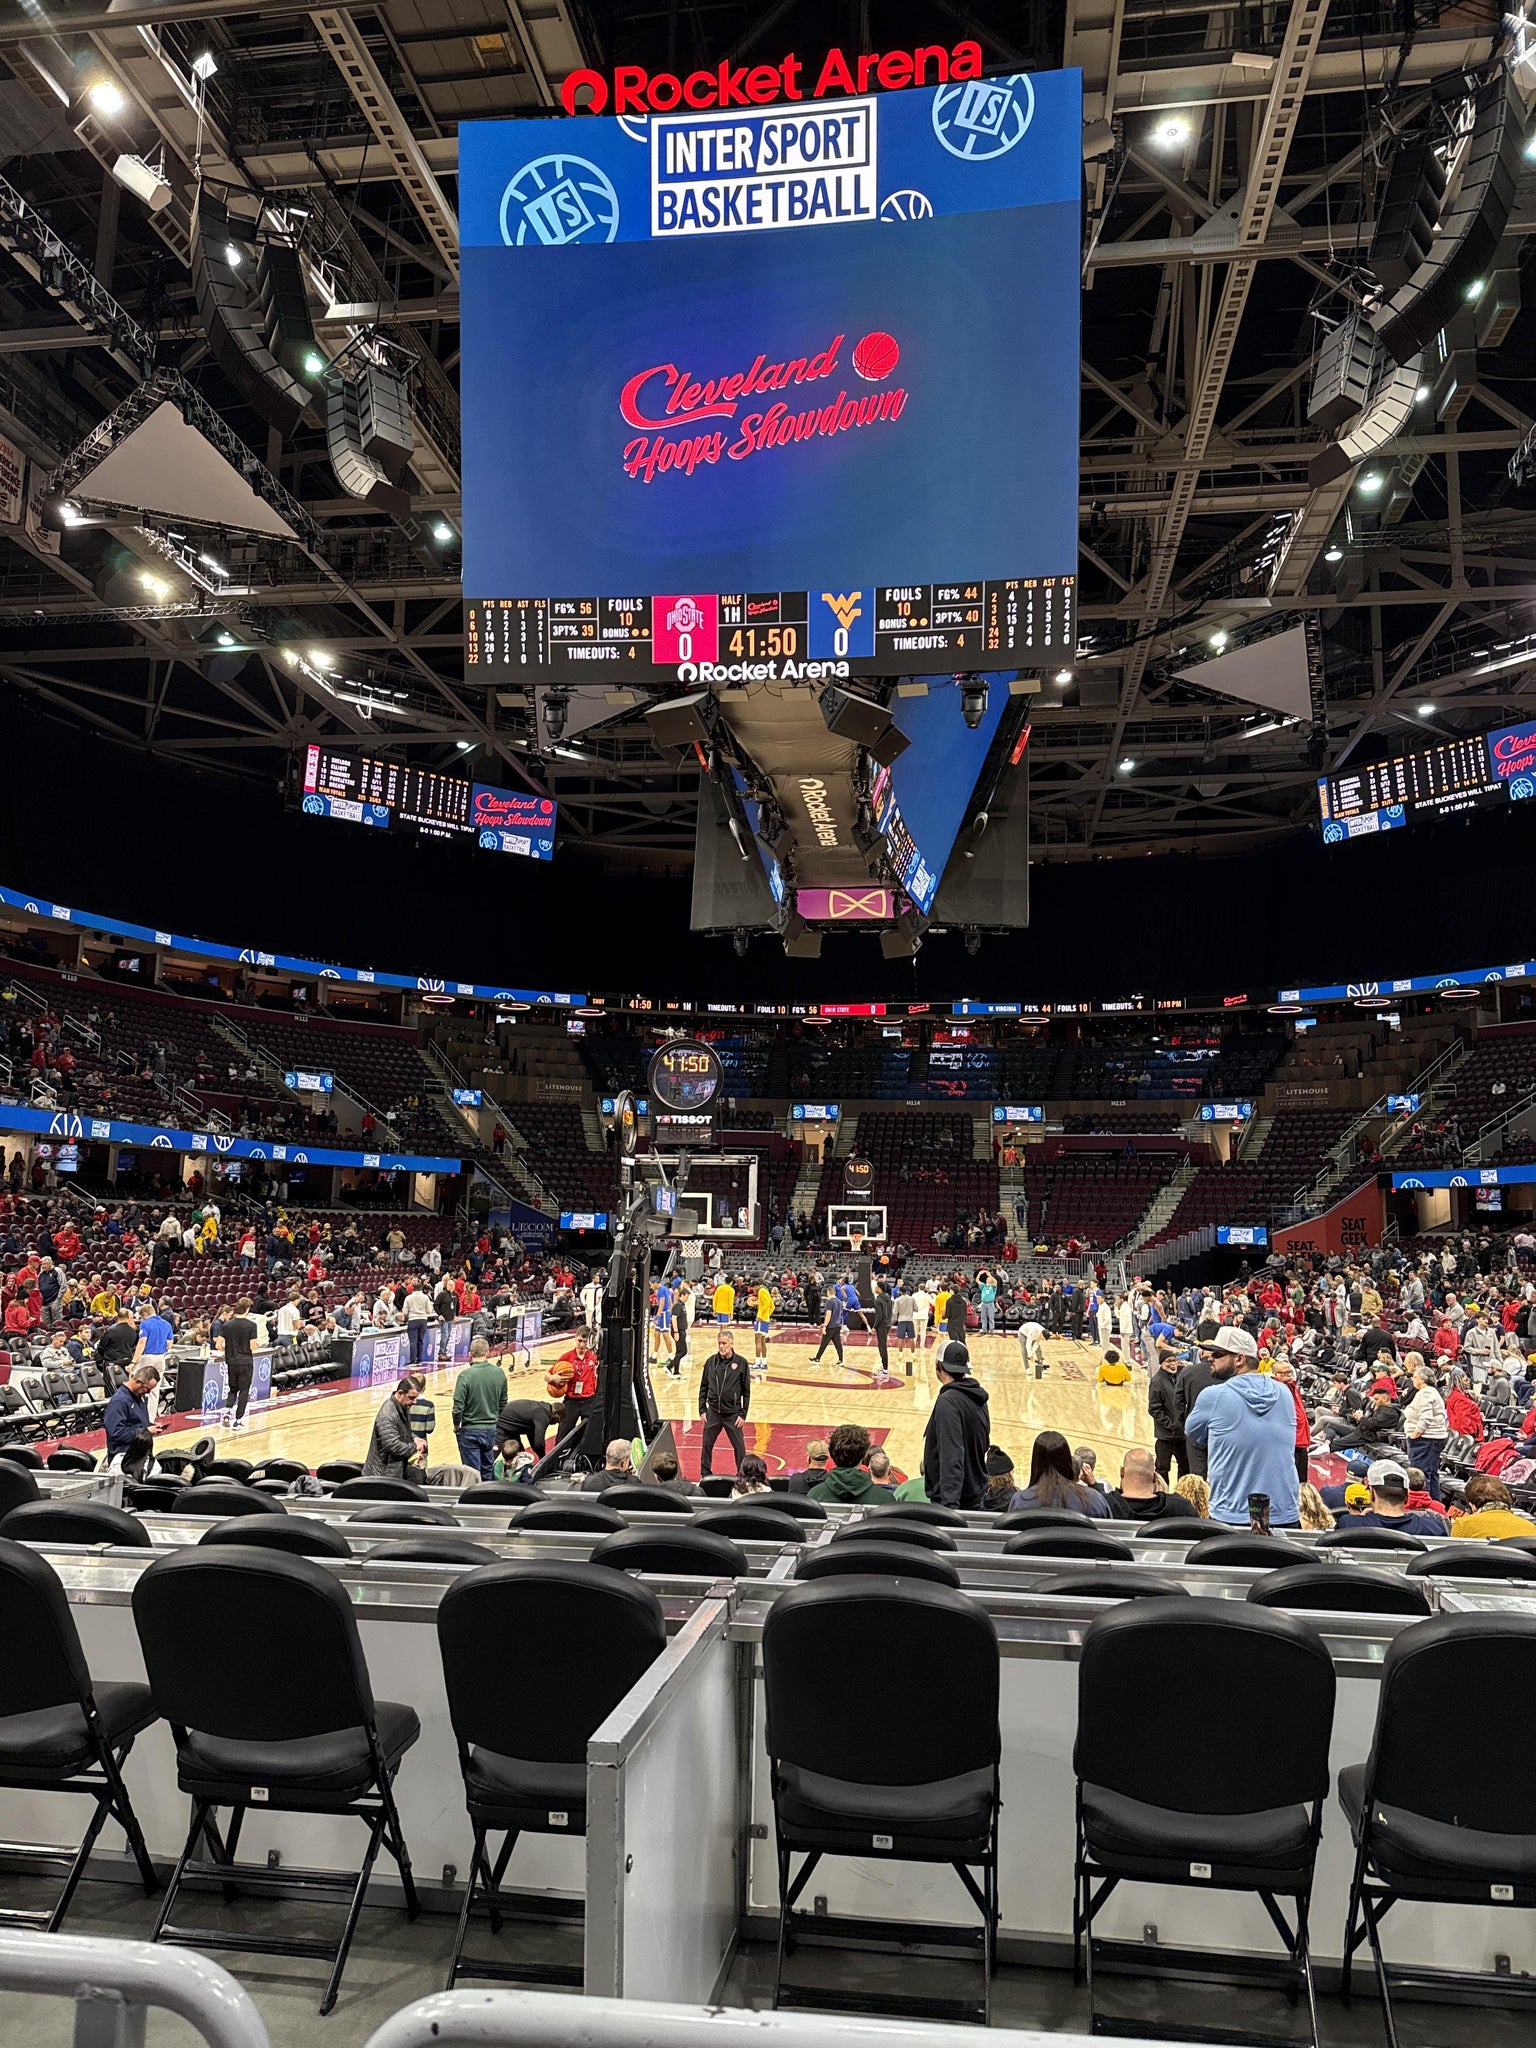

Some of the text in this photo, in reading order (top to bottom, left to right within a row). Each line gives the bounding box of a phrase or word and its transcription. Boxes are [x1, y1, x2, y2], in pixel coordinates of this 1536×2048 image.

[615, 40, 983, 114] Rocket Arena
[659, 175, 870, 229] BASKETBALL
[619, 334, 845, 430] Cleveland
[623, 388, 908, 483] Hoops Showdown
[1005, 577, 1075, 589] PTS REB AST FLS
[721, 595, 741, 605] HALF
[886, 588, 922, 601] FOULS
[938, 587, 978, 600] FG% 44
[991, 587, 1071, 603] 2 4 1 0 0
[517, 600, 529, 608] AST
[534, 600, 546, 608] FLS
[555, 602, 592, 614] FG% 56
[608, 599, 643, 611] FOULS
[897, 602, 911, 616] 10
[991, 599, 1070, 614] 3 12 4 3 2
[619, 613, 633, 625] 10
[723, 606, 741, 623] 1H
[935, 610, 979, 624] 3PT% 40
[991, 611, 1070, 626] 5 15 3 5 4
[553, 625, 594, 636] 3PT% 39
[879, 618, 907, 629] BONUS
[988, 622, 1070, 637] 24 9 4 2 2
[603, 628, 629, 638] BONUS
[679, 633, 692, 660] 0
[729, 627, 796, 657] 41:50
[834, 628, 848, 656] 0
[893, 634, 965, 650] TIMEOUTS: 4
[988, 634, 1070, 649] 32 5 4 0 0
[567, 646, 636, 659] TIMEOUTS: 4
[700, 659, 849, 681] Rocket Arena
[1497, 754, 1535, 777] Hoops
[475, 793, 538, 813] Cleveland
[1415, 787, 1483, 809] STATE BUCKEYES WILL
[400, 813, 417, 821] STATE
[474, 812, 552, 827] Hoops Showdown
[801, 790, 838, 846] Rocket Arena
[629, 1000, 651, 1009] 41:50
[682, 1002, 691, 1010] 1H
[707, 1004, 737, 1012] TIMEOUTS:
[739, 1004, 745, 1013] 4
[777, 1006, 786, 1014] 10
[808, 1006, 817, 1014] 56
[870, 1006, 876, 1014] 0
[962, 1005, 968, 1014] 0
[1079, 1004, 1087, 1012] 10
[1102, 1003, 1134, 1011] TIMEOUTS:
[1137, 1002, 1142, 1010] 4
[663, 1056, 709, 1072] 41:50
[671, 1116, 712, 1124] TISSOT
[849, 1165, 869, 1173] 41:50
[1341, 1217, 1367, 1231] SEAT
[1287, 1240, 1315, 1251] SEAT
[1341, 1231, 1368, 1246] GEEK
